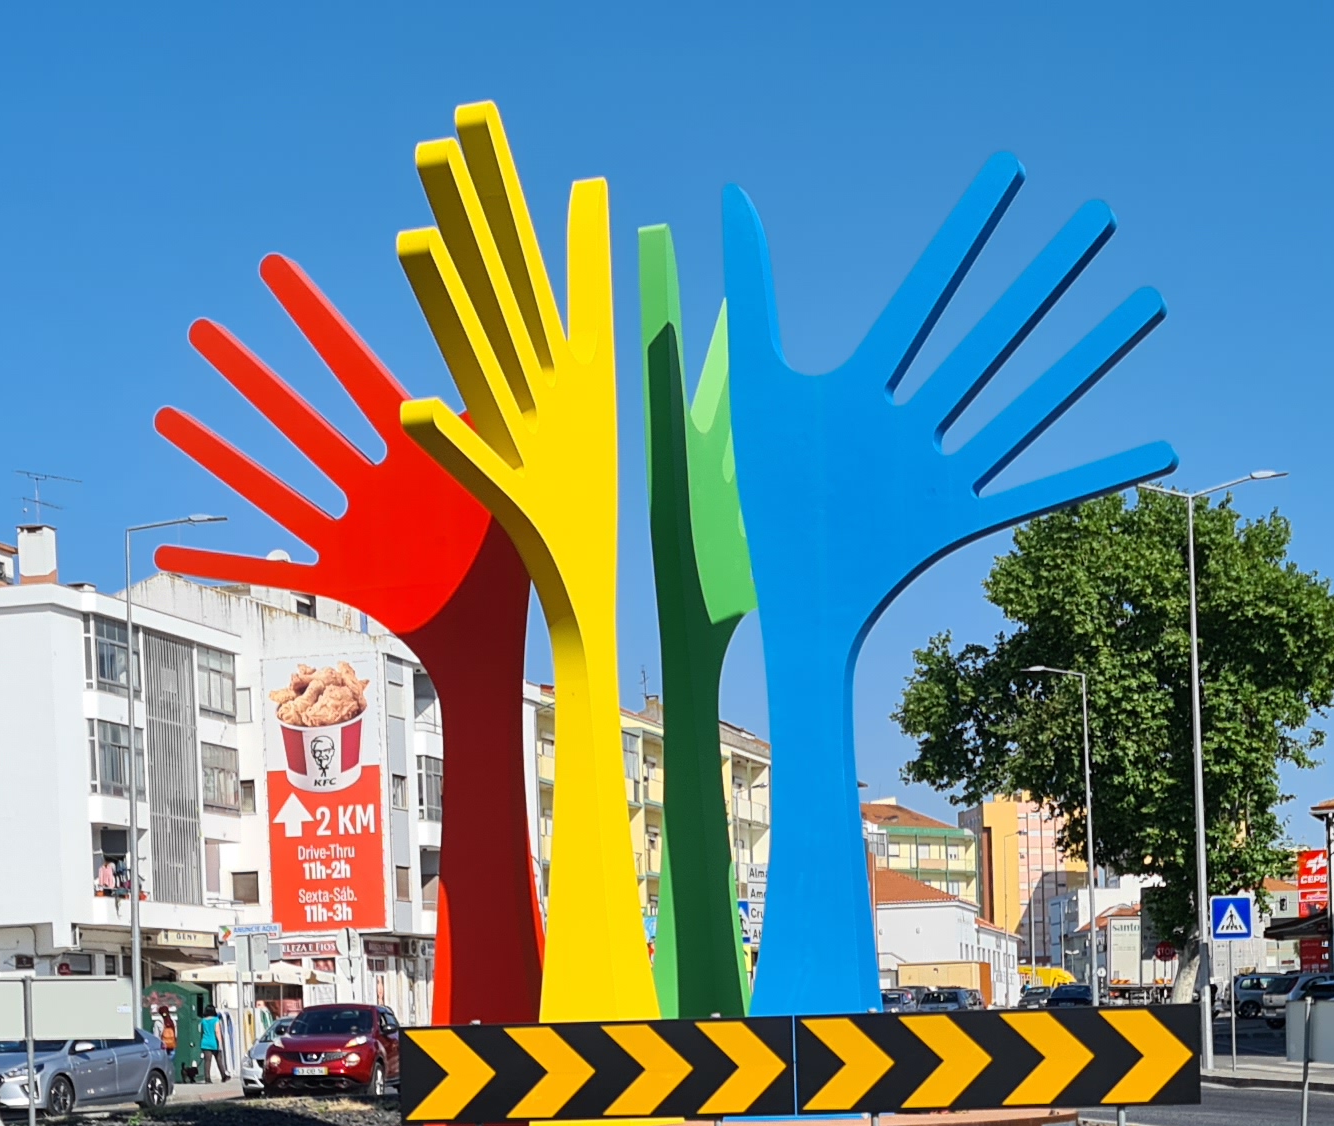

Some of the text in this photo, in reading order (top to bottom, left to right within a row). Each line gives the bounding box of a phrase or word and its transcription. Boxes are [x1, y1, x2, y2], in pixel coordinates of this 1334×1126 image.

[314, 777, 336, 787] KFC
[316, 804, 375, 836] 2 KM
[298, 843, 355, 860] Drive-Thru
[303, 860, 351, 880] 11h-2h
[298, 886, 357, 904] Sexta-Sáb.
[304, 903, 352, 922] 11h-3h
[1157, 947, 1174, 956] STOP
